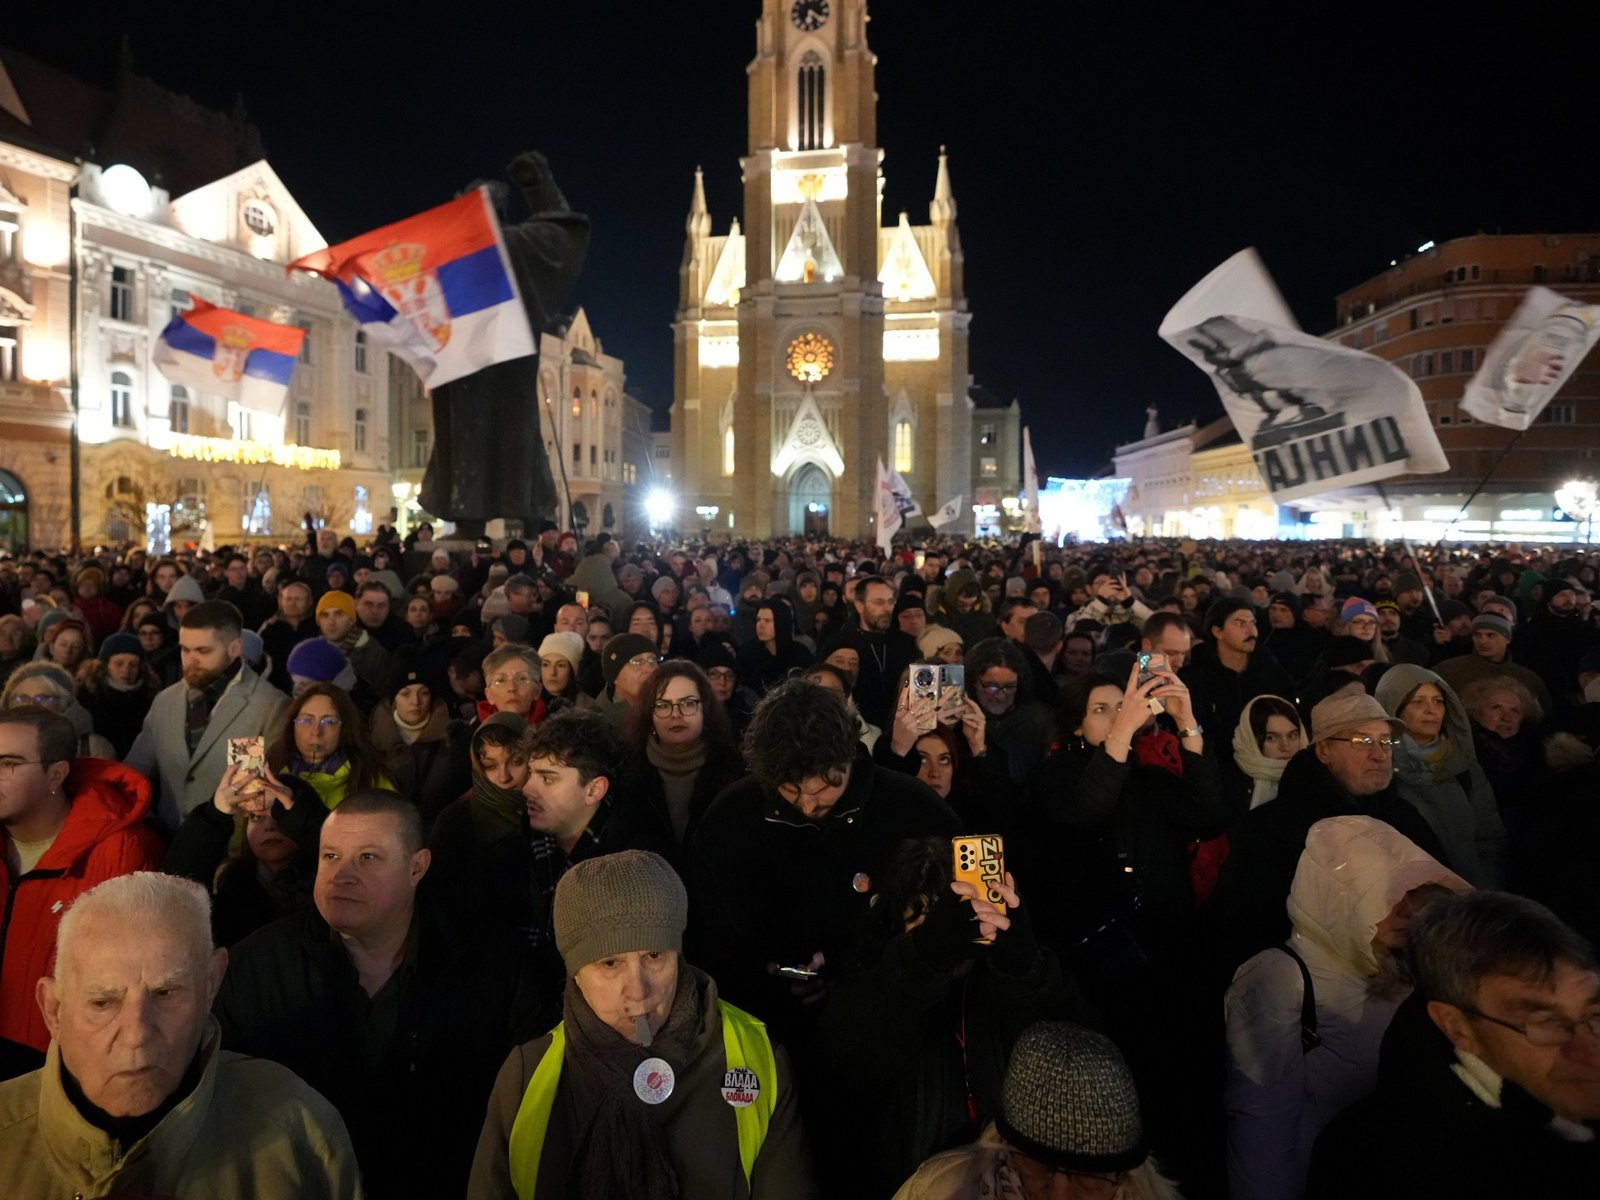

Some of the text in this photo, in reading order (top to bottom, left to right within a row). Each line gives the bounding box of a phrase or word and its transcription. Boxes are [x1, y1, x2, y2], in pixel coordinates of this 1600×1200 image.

[1253, 416, 1409, 492] АЈНИЦ
[724, 1072, 758, 1089] ВЛАДА
[726, 1091, 754, 1103] БЛОКАДА
